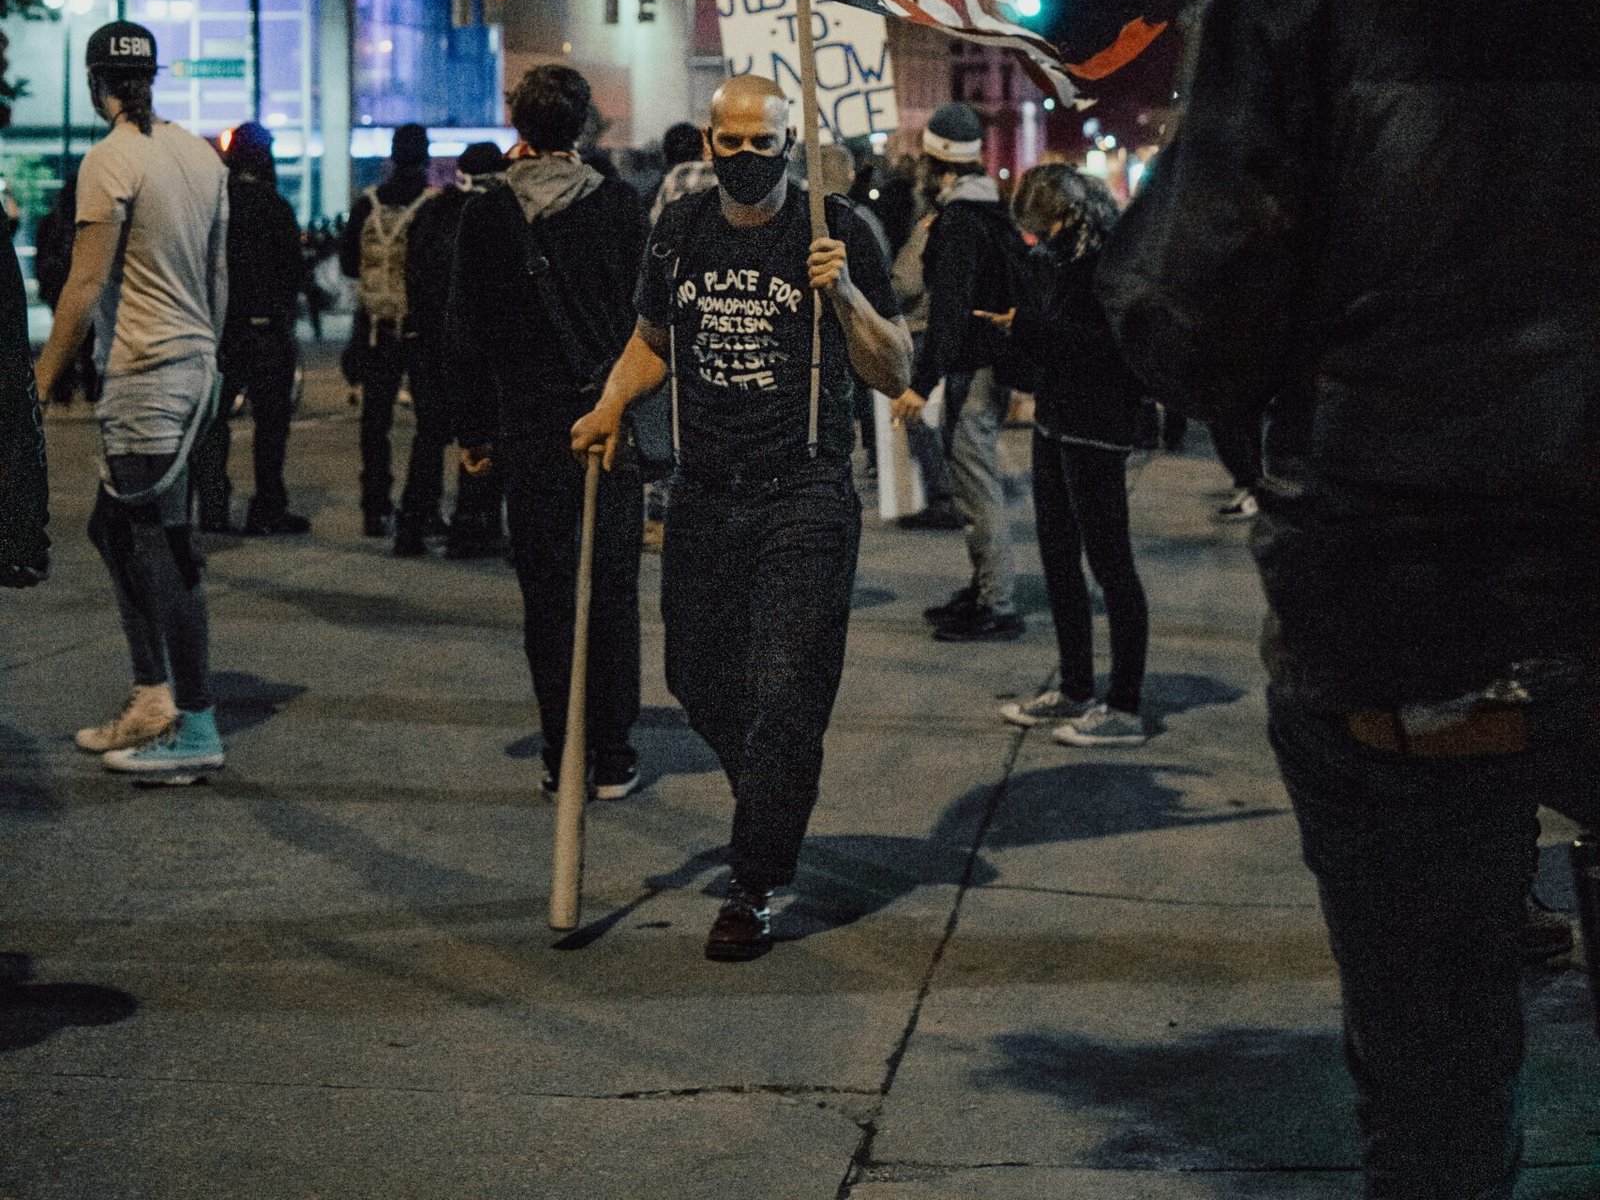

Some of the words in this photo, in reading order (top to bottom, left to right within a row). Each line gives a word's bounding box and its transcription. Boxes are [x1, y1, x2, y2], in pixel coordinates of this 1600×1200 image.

[777, 11, 828, 42] TO
[677, 280, 697, 308] NO
[704, 269, 760, 292] PLACE
[768, 277, 803, 312] FOR
[696, 296, 780, 316] HOMOPHOBIA
[701, 314, 774, 333] FASCISM
